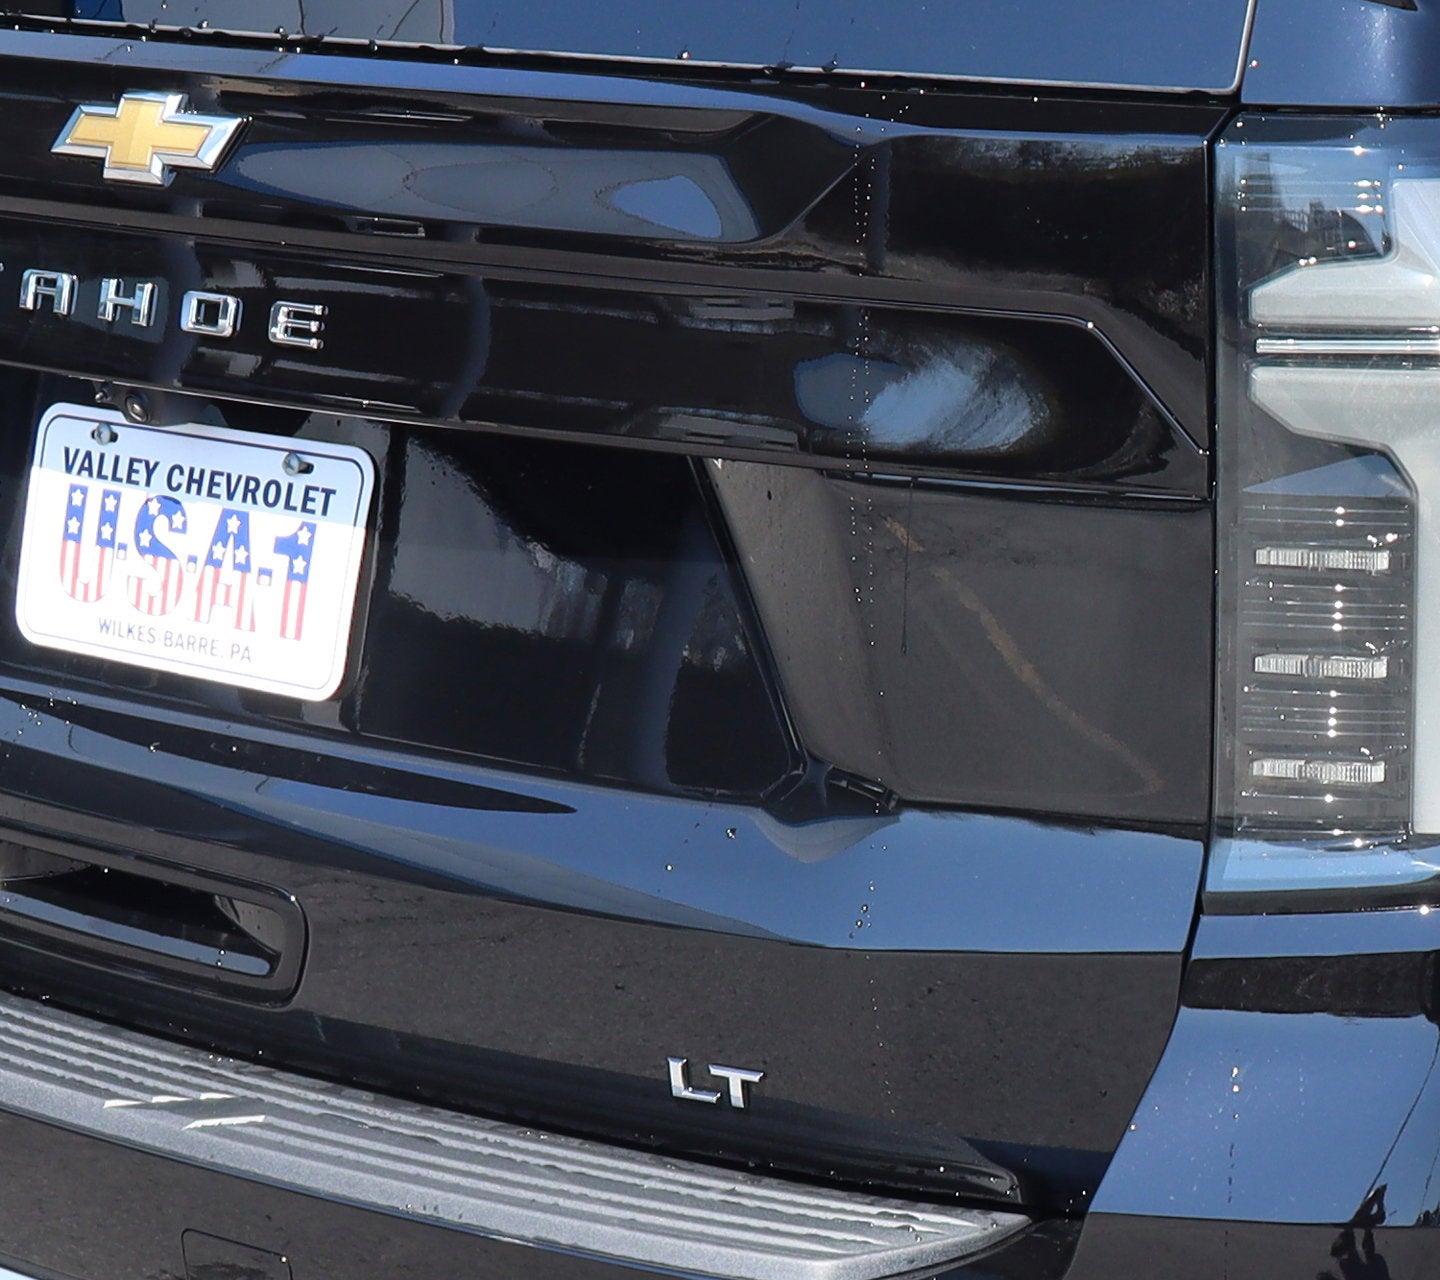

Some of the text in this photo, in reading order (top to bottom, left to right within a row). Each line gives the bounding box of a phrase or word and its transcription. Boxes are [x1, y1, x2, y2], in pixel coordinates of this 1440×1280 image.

[63, 446, 337, 517] VALLEY CHEVROLET
[230, 643, 252, 663] PA
[666, 1056, 765, 1109] LT
